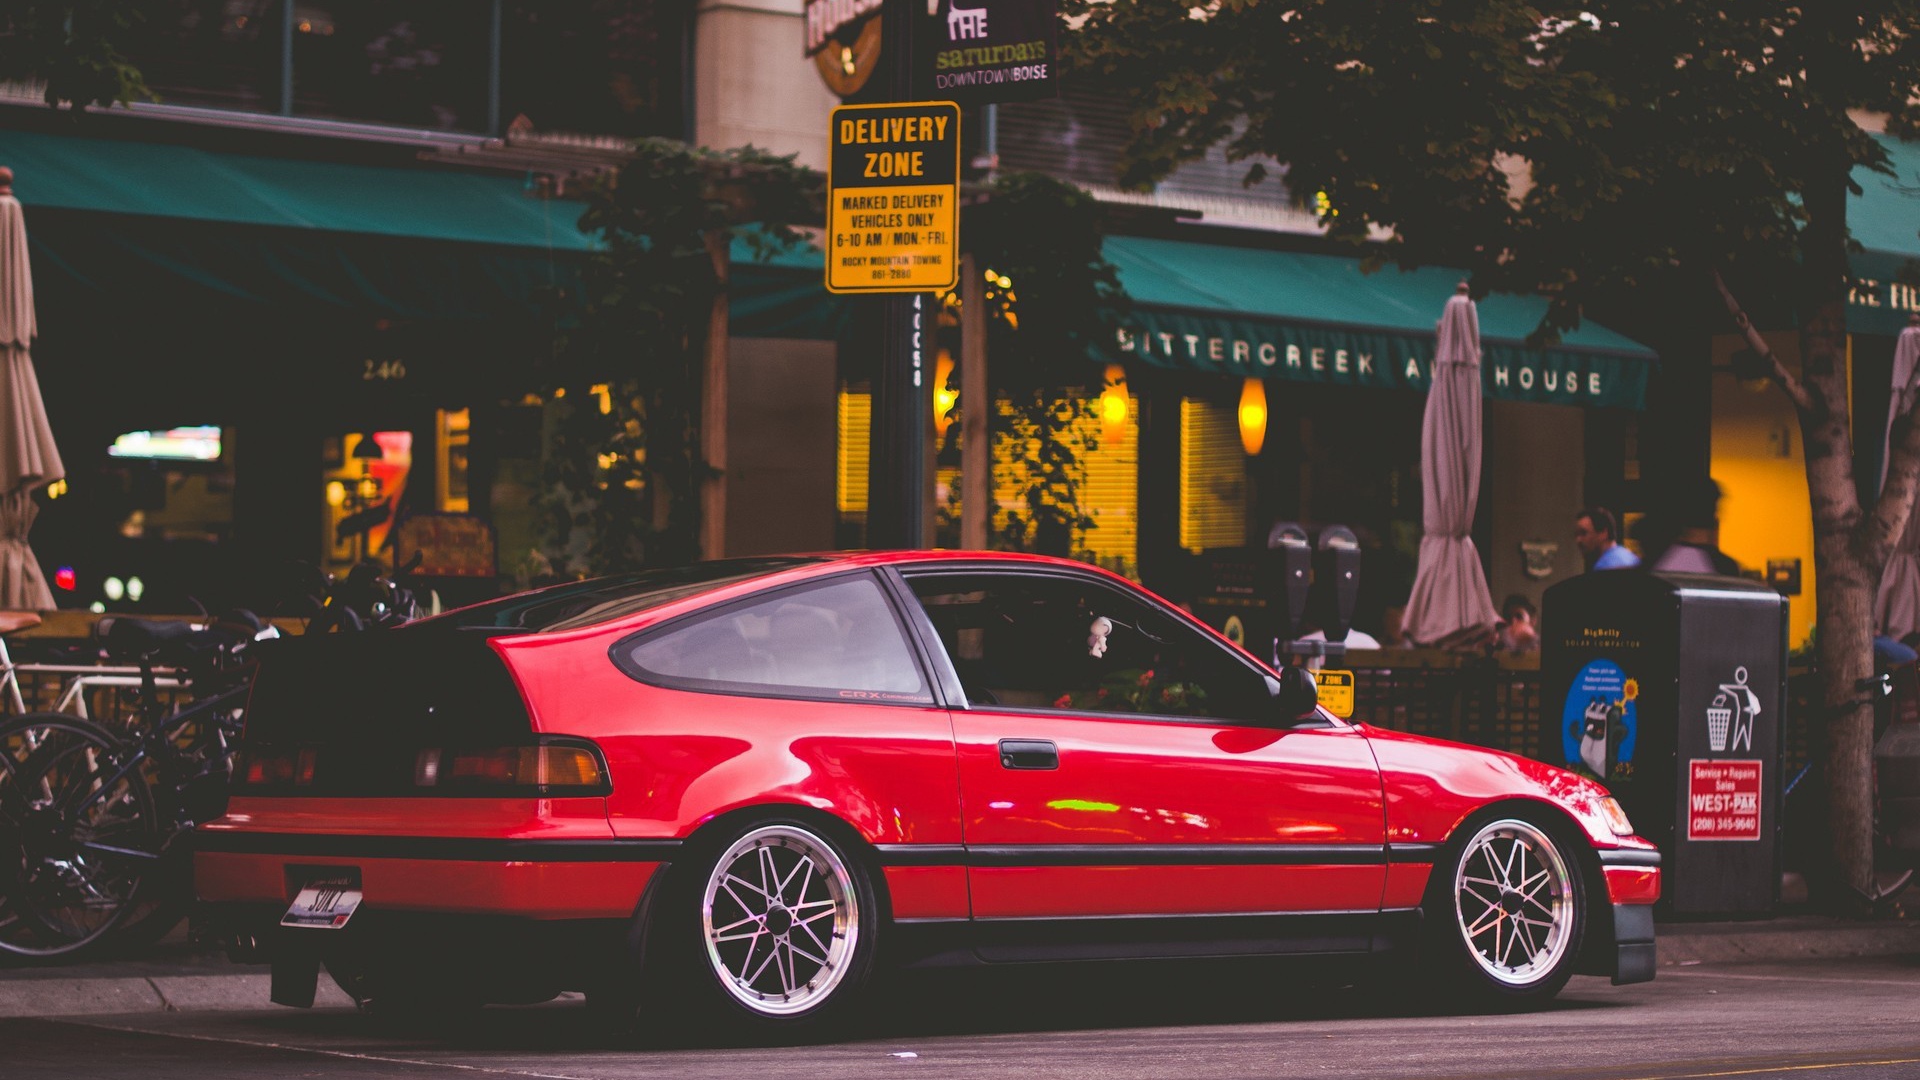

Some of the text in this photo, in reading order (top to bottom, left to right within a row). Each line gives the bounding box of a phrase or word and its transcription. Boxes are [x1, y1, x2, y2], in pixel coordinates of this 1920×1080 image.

[948, 7, 988, 41] THE
[840, 116, 948, 145] DELIVERY
[864, 151, 924, 178] ZONE
[842, 194, 944, 211] MARKED DELIVERY
[852, 213, 934, 229] VEHICLES ONLY
[837, 233, 861, 247] 6-10
[866, 233, 882, 246] AM
[842, 255, 942, 267] ROCKY MOUNTAIN TOWING
[363, 359, 406, 381] 246
[1495, 365, 1601, 395] HOUSE
[1695, 767, 1756, 780] Service Repairs
[1715, 780, 1735, 791] Sales
[1693, 817, 1715, 832] (208)
